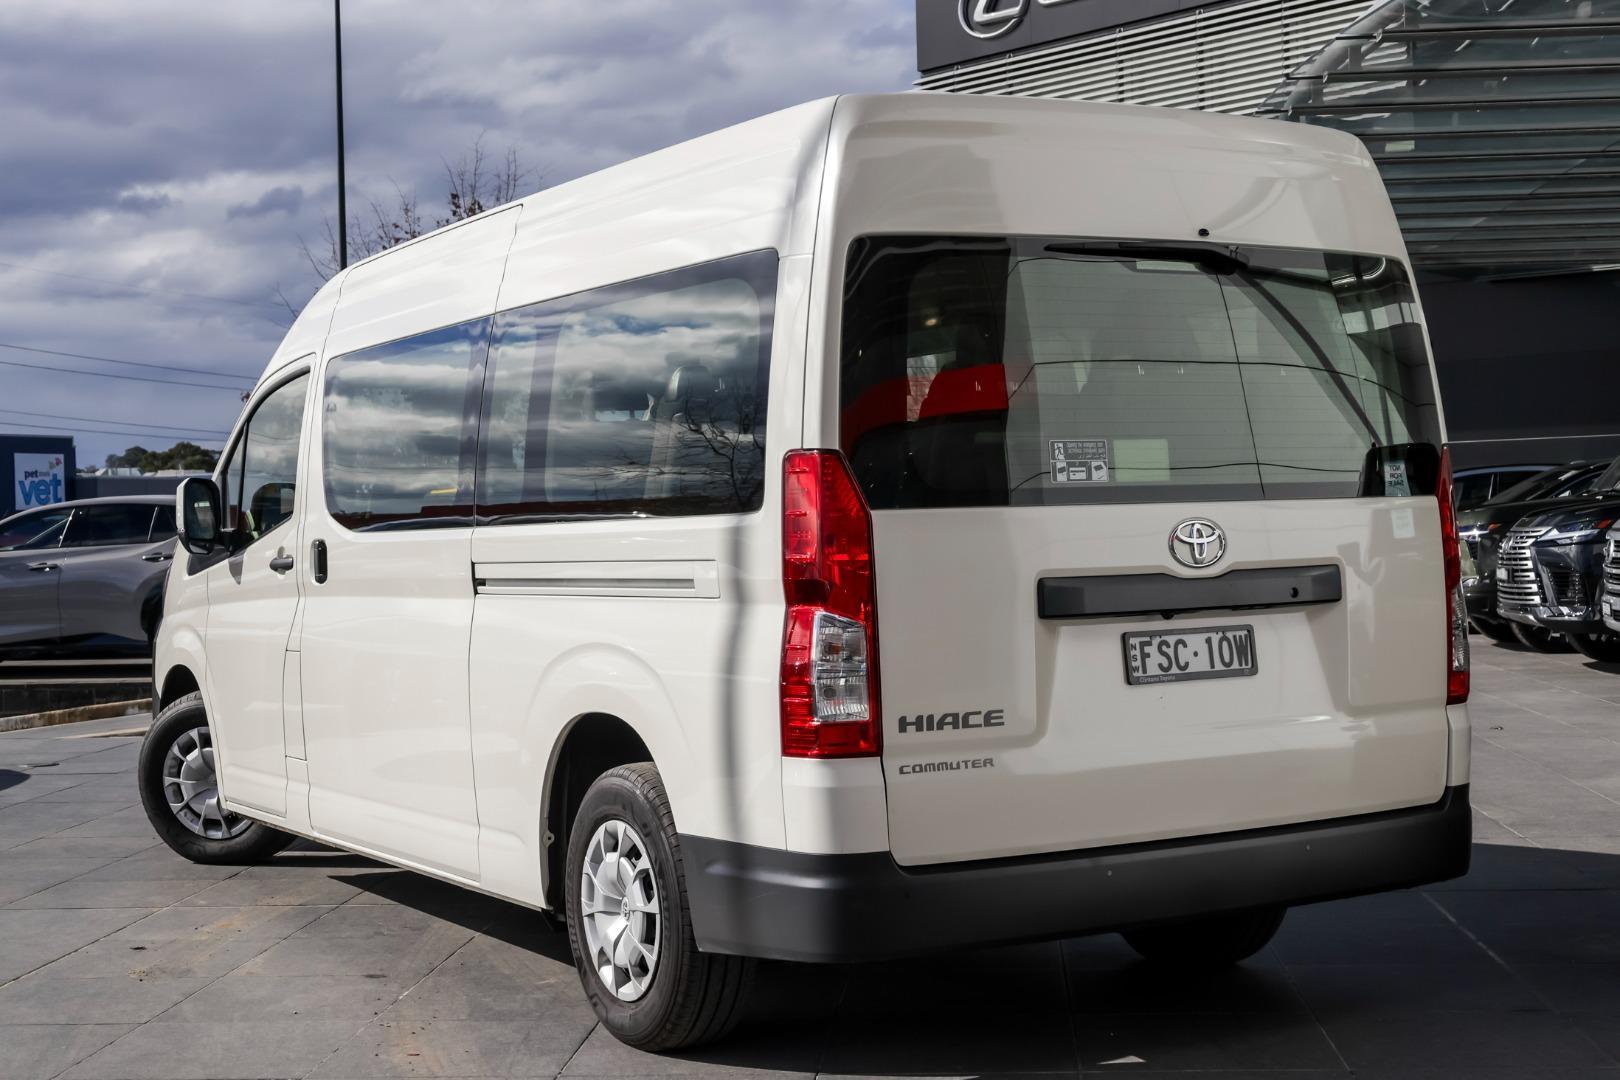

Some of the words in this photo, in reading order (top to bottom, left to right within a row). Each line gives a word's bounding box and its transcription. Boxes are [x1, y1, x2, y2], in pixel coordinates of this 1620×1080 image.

[24, 469, 39, 480] pet
[18, 473, 62, 506] vet
[898, 708, 1005, 733] HIACE
[898, 757, 995, 775] COMMUTER
